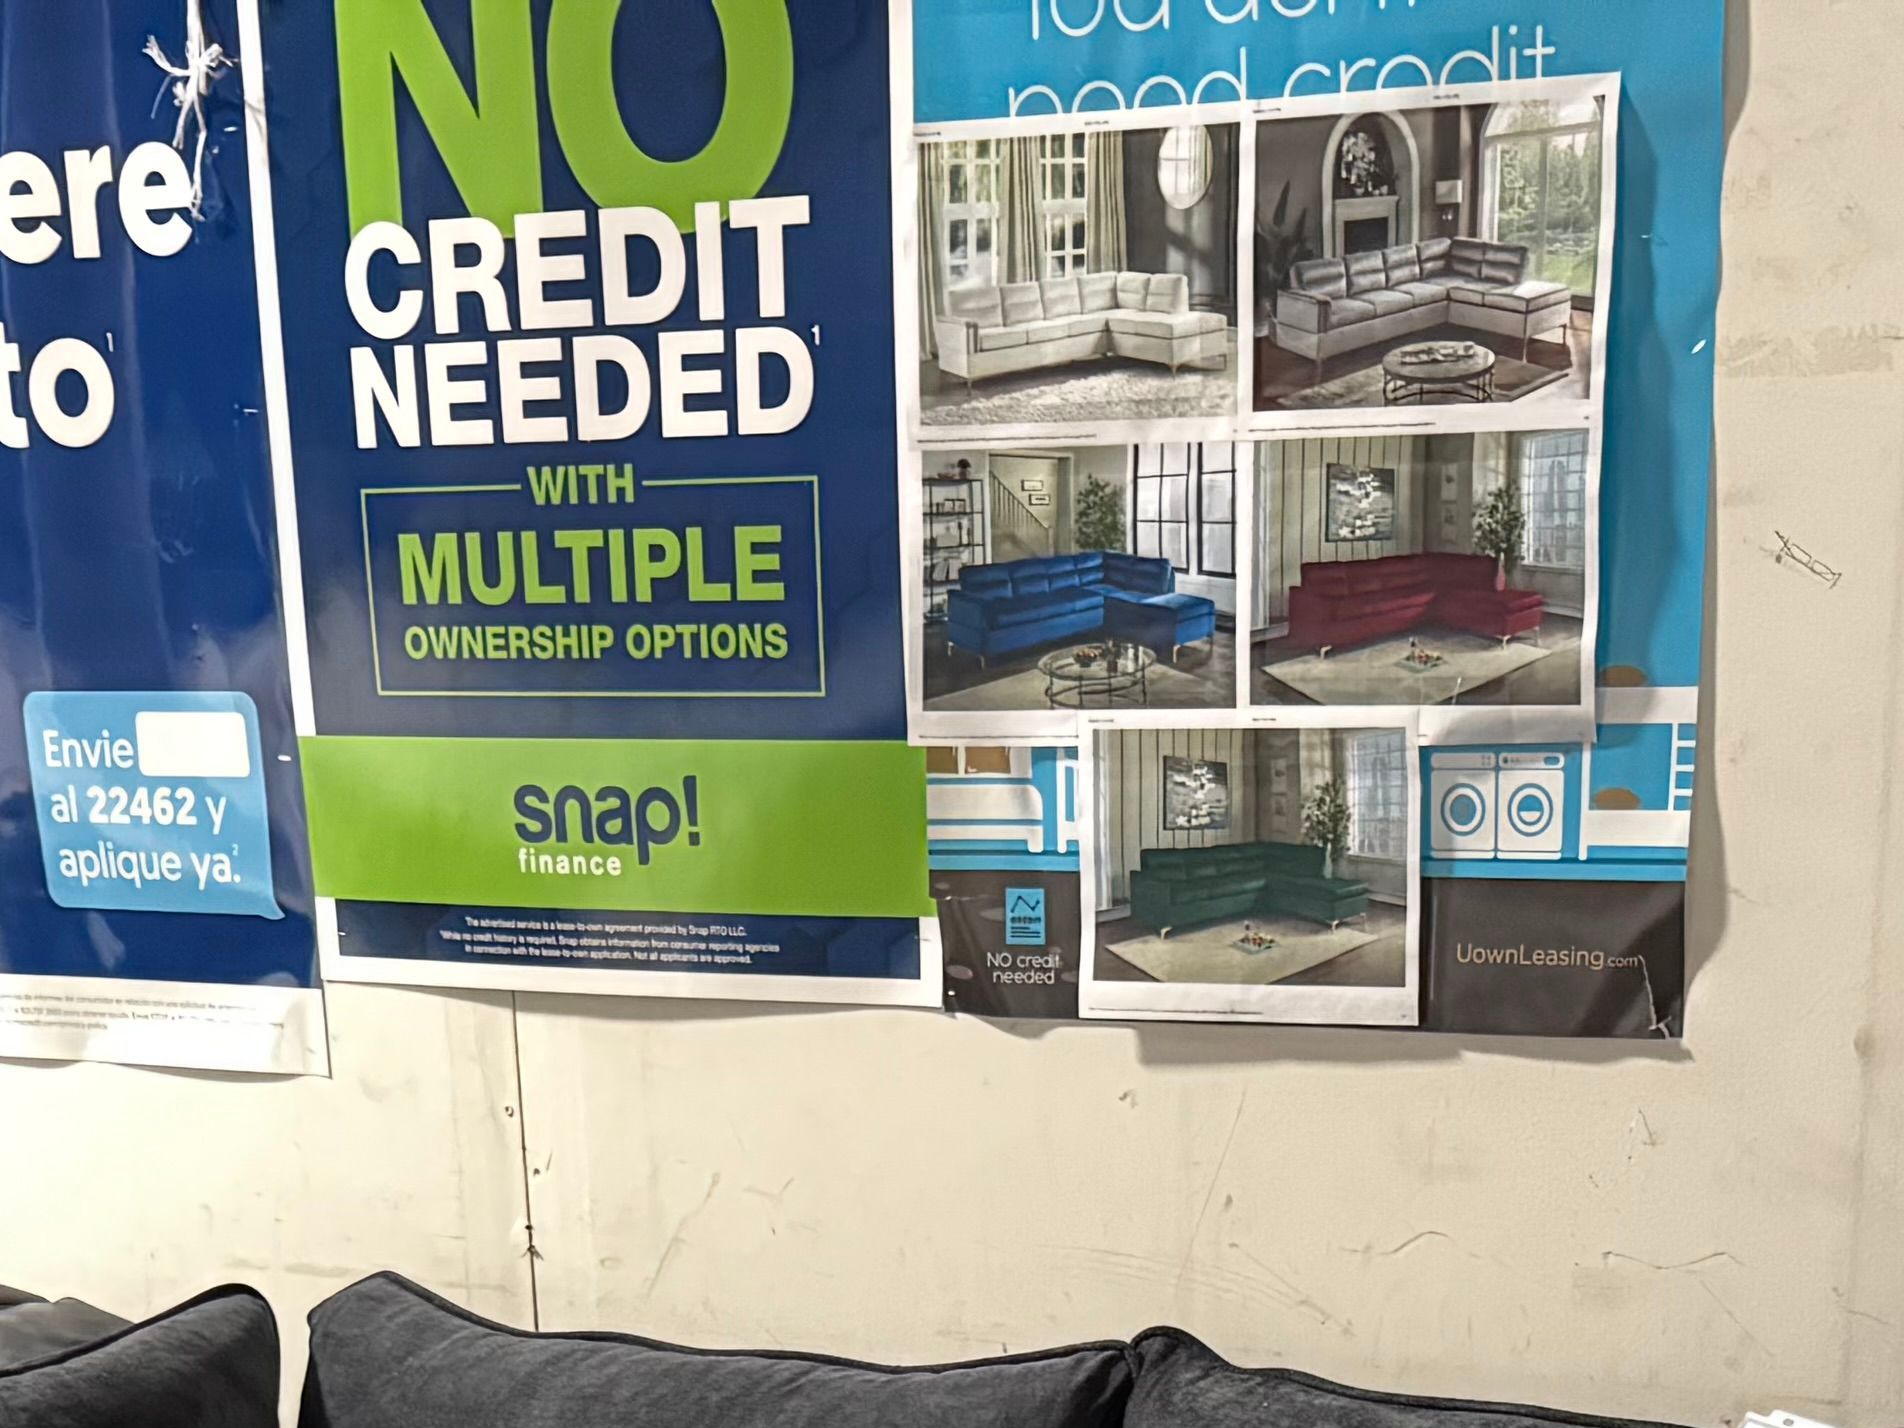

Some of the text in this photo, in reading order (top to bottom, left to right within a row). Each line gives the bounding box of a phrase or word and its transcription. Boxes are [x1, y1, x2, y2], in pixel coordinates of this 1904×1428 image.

[334, 0, 793, 238] NO
[344, 195, 810, 340] CREDIT
[526, 463, 635, 505] WITH
[397, 525, 786, 606] MULTIPLE
[404, 622, 789, 661] OWNERSHIP OPTIONS
[43, 729, 134, 769] Envie
[51, 784, 227, 835] al 22462 y
[514, 775, 701, 865] snap!
[59, 840, 183, 889] aplique
[517, 848, 623, 877] finance
[986, 951, 1012, 967] NO
[992, 970, 1055, 984] needed
